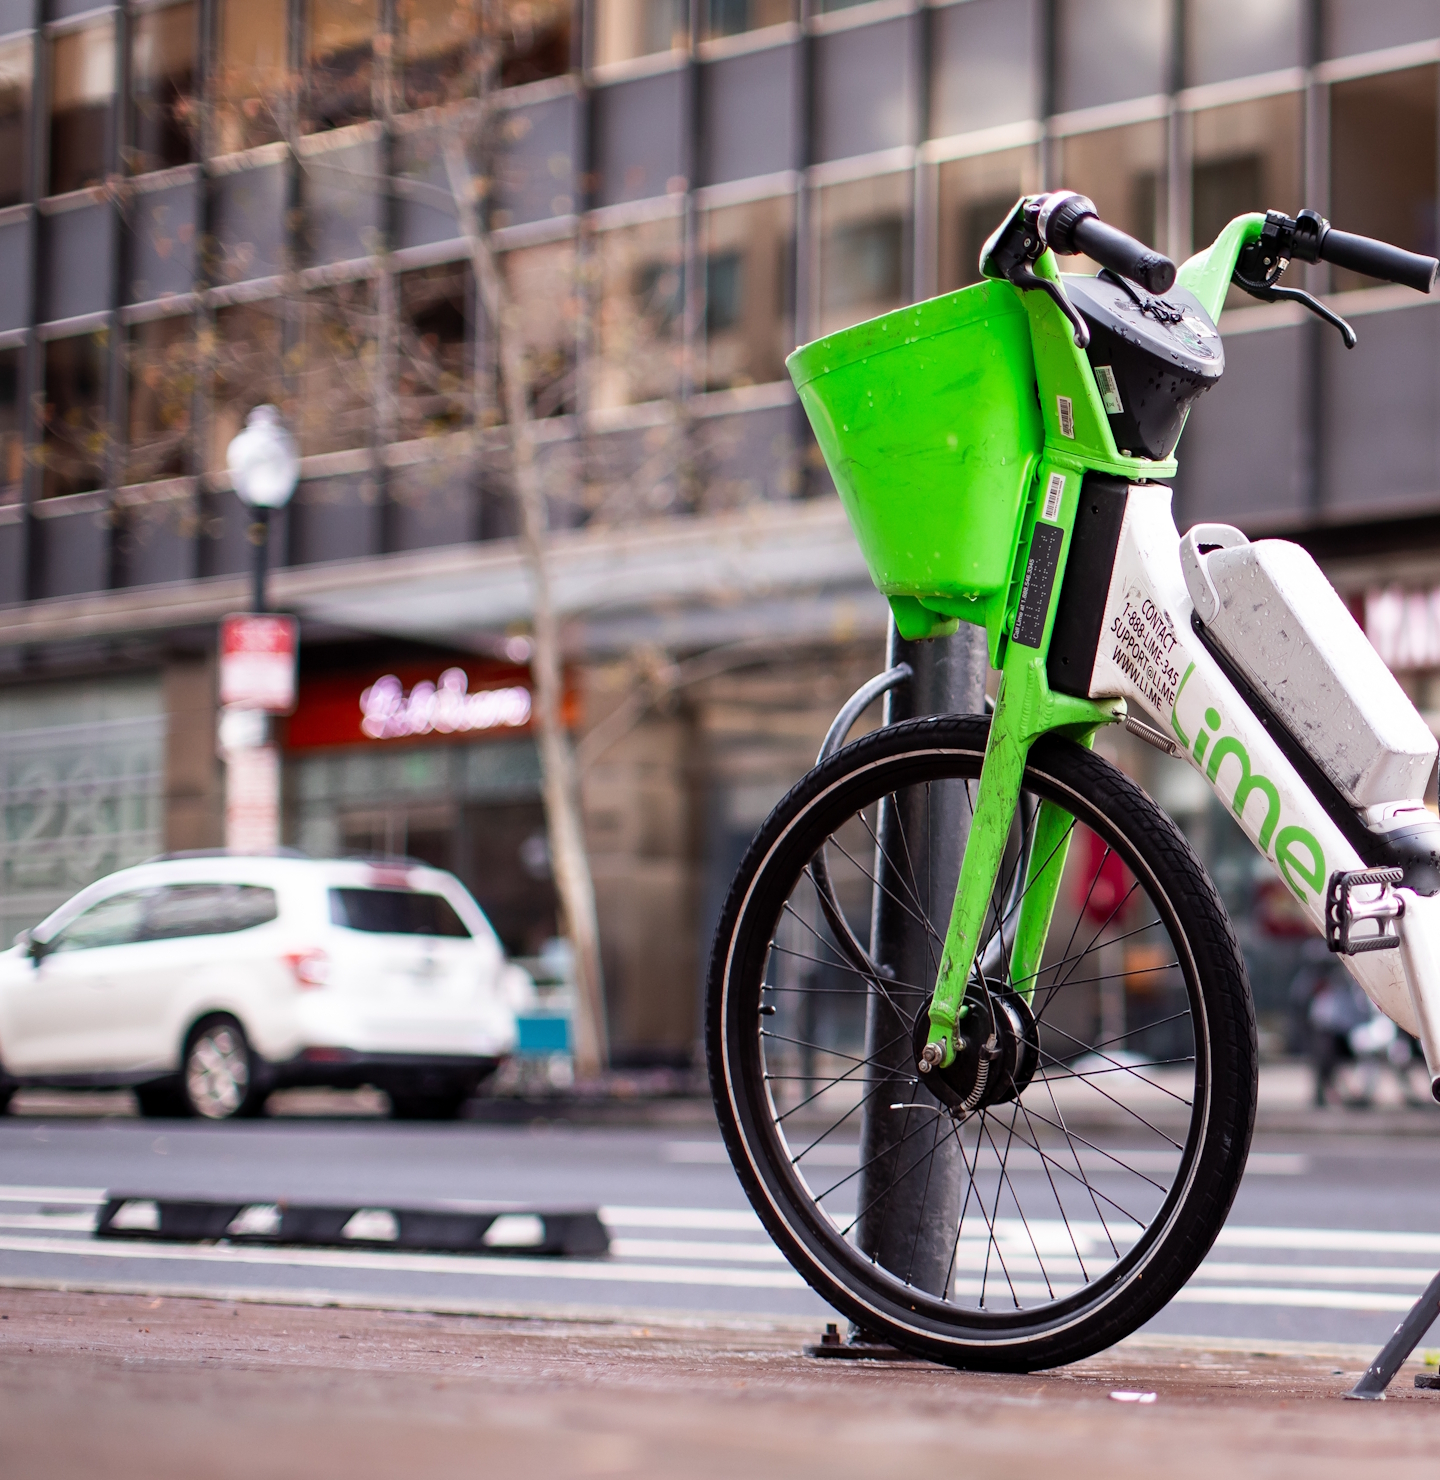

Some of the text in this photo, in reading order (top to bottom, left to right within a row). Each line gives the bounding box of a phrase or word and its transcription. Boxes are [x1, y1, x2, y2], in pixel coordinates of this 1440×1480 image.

[1110, 617, 1175, 707] SUPPORT@LI.ME
[1123, 602, 1179, 686] 1-888-LIME-345
[1142, 599, 1178, 653] CONTACT
[1112, 645, 1162, 712] WWW.LI.ME
